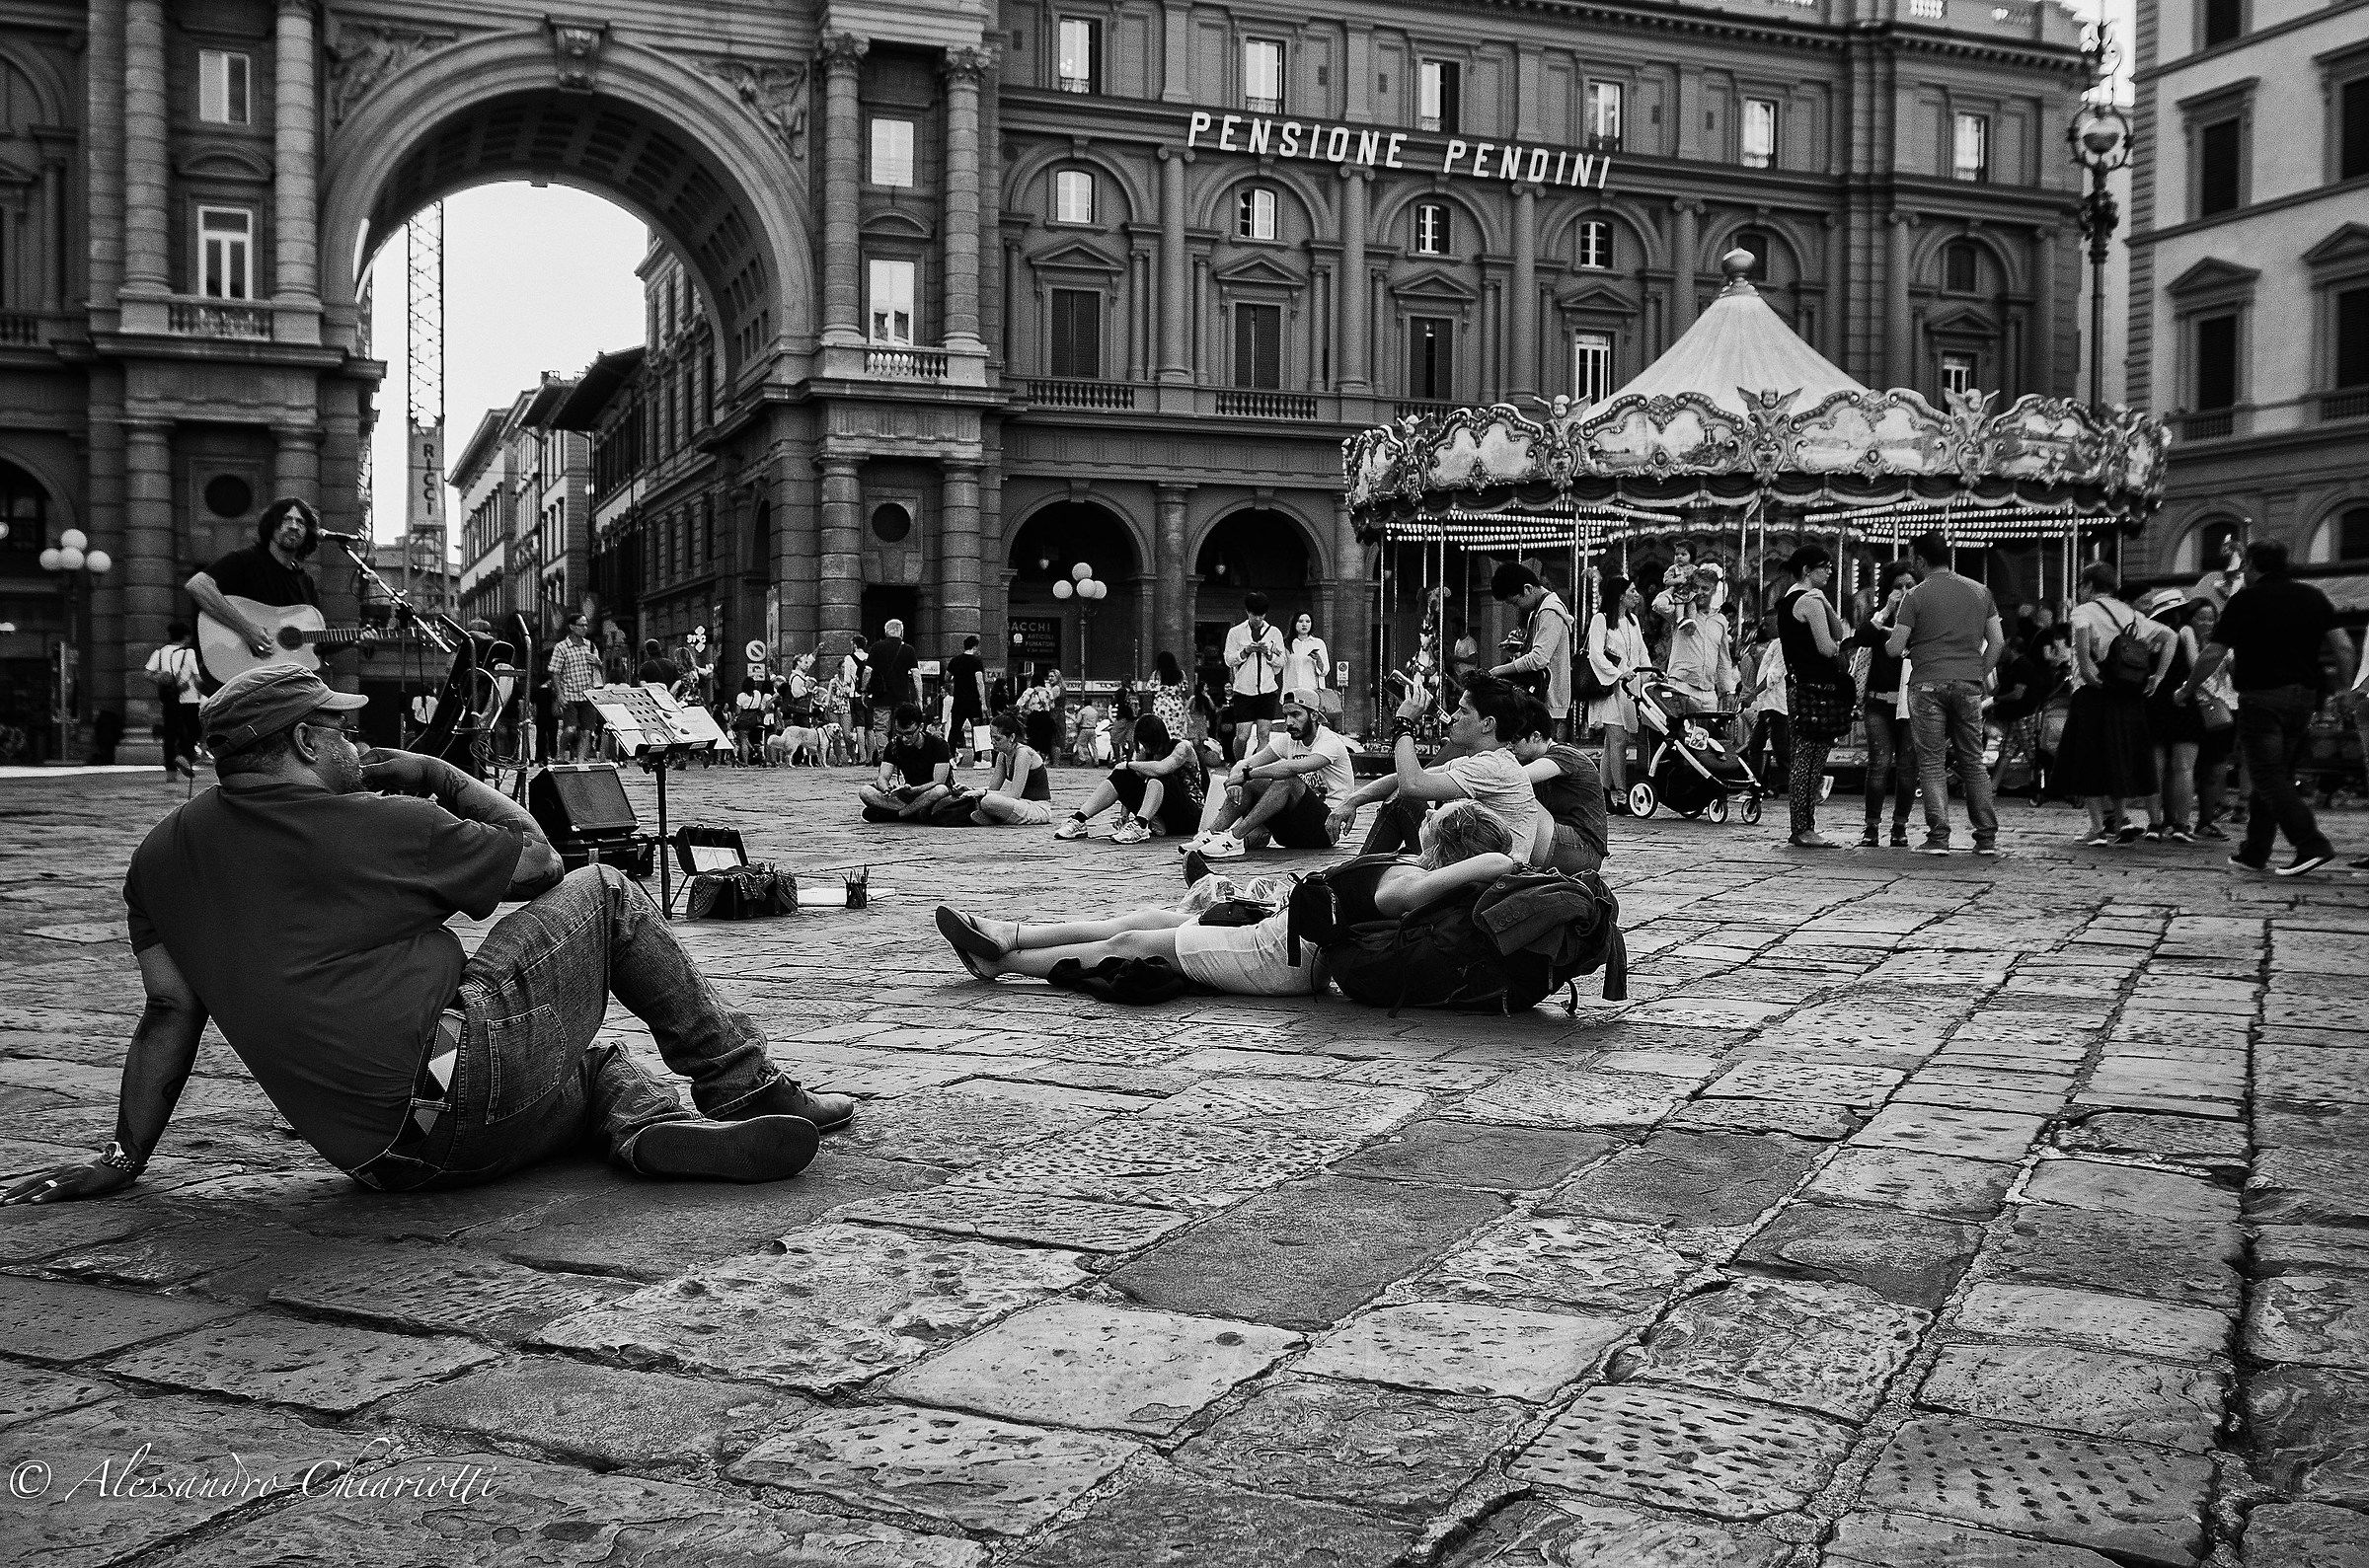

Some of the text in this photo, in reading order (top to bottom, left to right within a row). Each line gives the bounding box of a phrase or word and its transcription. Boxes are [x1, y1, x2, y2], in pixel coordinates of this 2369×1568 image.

[1187, 112, 1611, 189] PENSIONE PENDINI
[423, 443, 434, 515] RICCI
[1007, 622, 1050, 632] ACCHI
